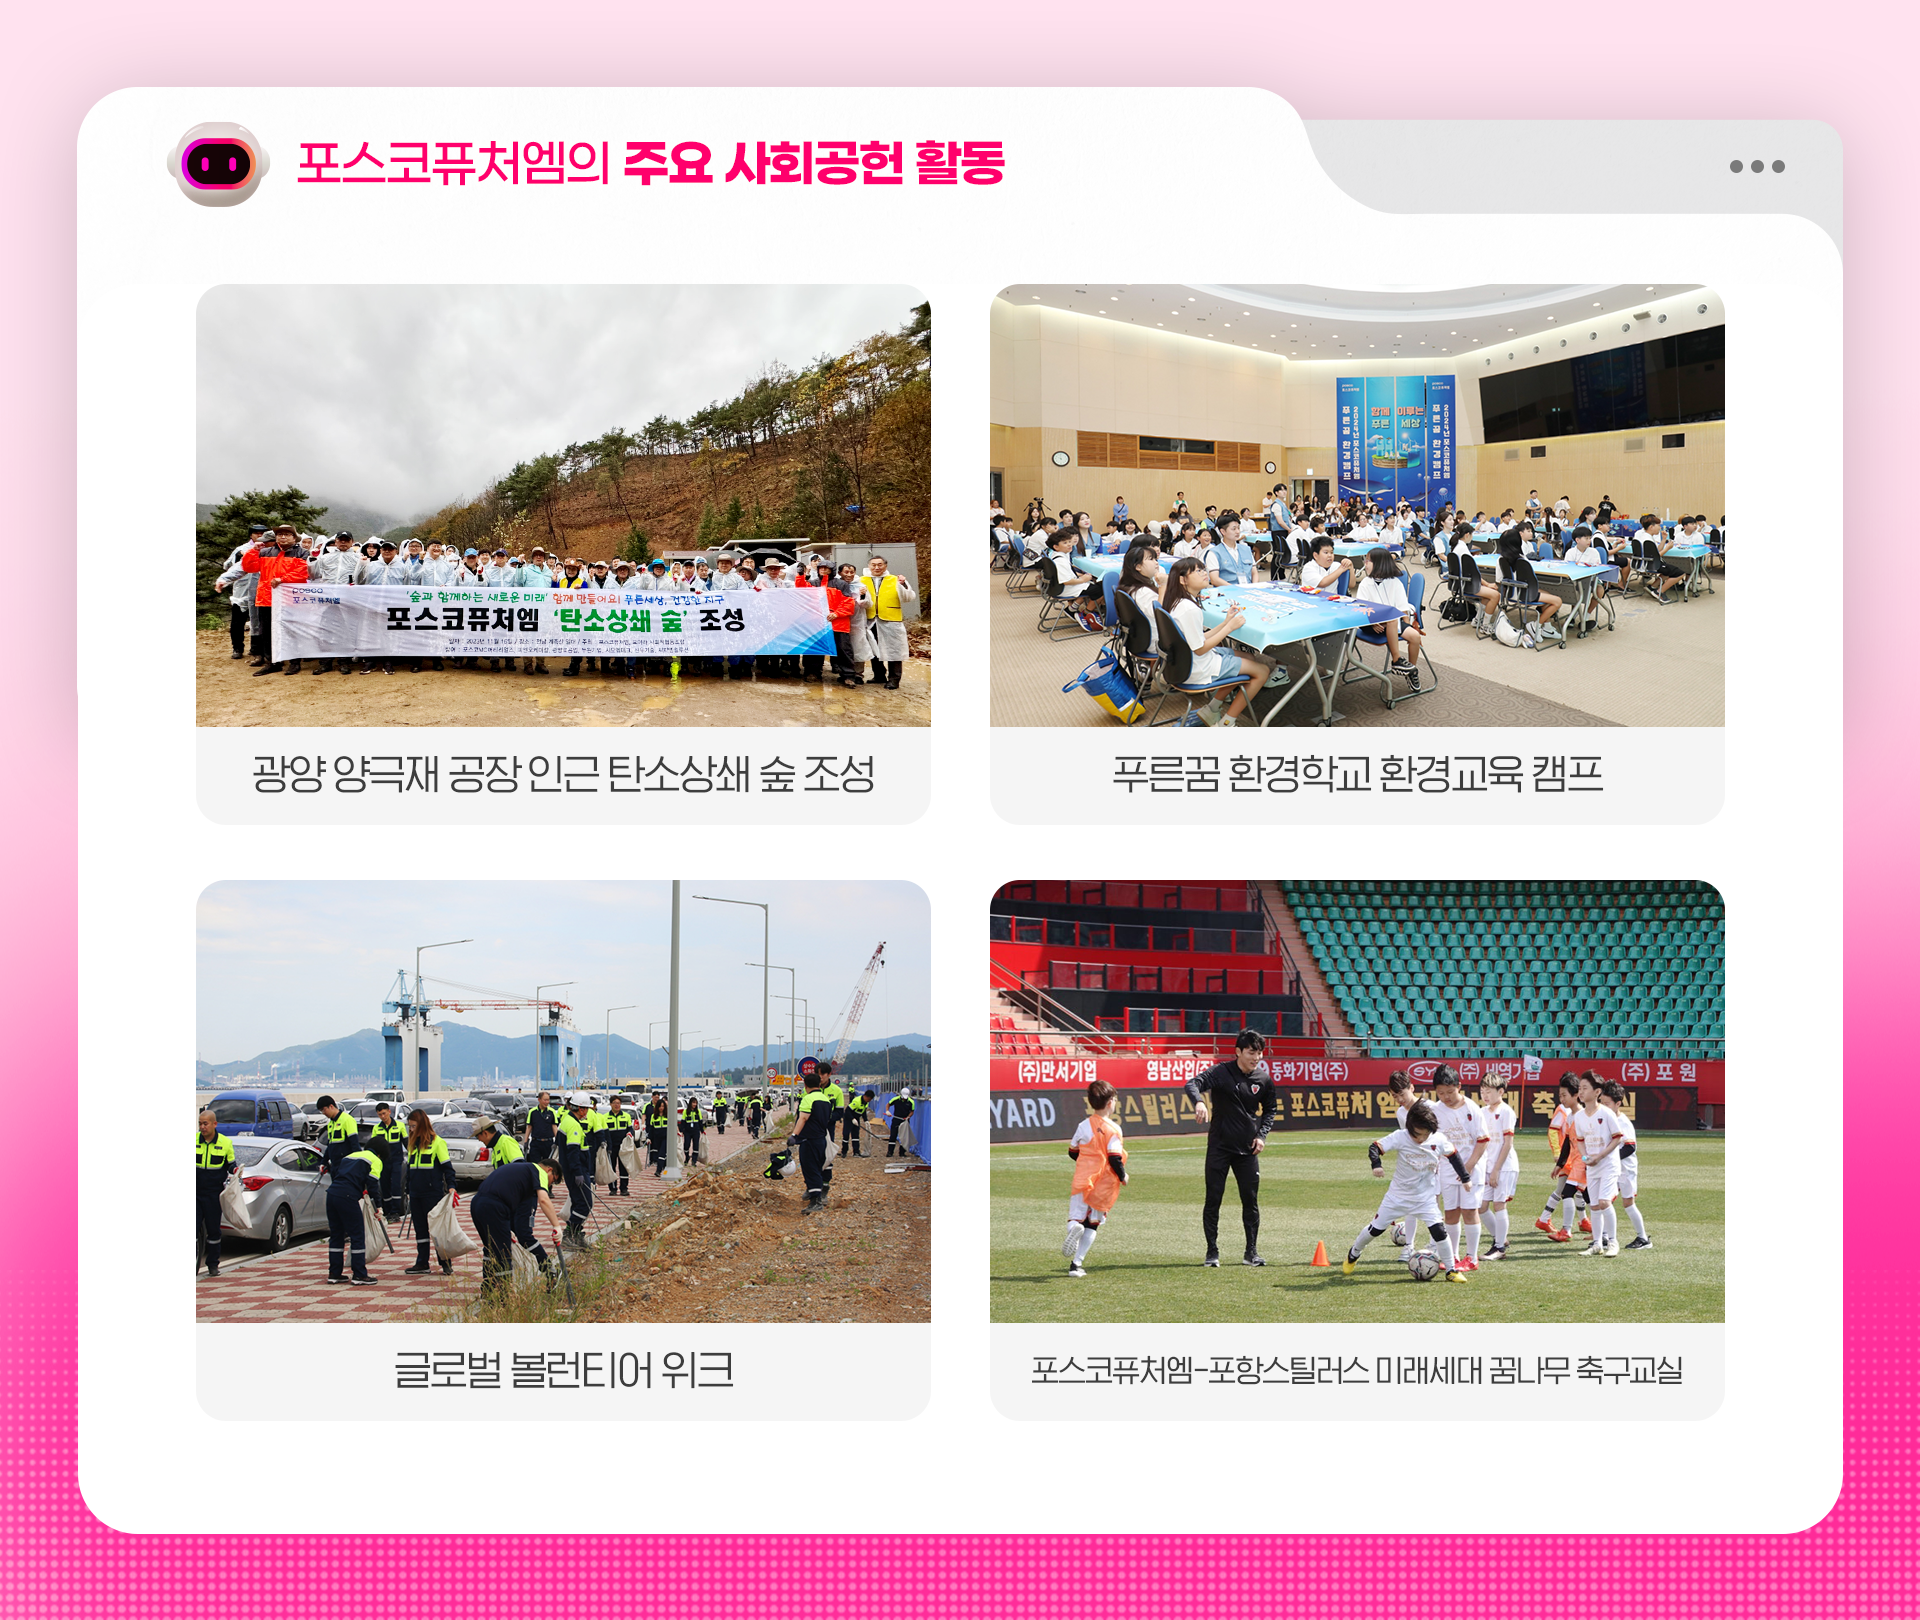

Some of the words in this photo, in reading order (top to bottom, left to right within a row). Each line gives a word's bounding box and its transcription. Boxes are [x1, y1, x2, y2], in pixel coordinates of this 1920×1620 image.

[1371, 406, 1391, 417] 함께
[1397, 406, 1425, 416] 이루는
[1371, 419, 1390, 429] 푸른
[1401, 418, 1421, 429] 세상
[1342, 440, 1351, 480] 환경캠프
[1432, 439, 1441, 479] 환경캠프
[438, 591, 484, 603] 함께하는
[487, 592, 520, 603] 새로운
[552, 593, 573, 605] 함께
[704, 595, 725, 605] 지구
[387, 607, 539, 632] 포스코퓨처엠
[699, 608, 745, 632] 조성
[1018, 1060, 1097, 1083] (주)만서기업
[1271, 1061, 1349, 1082] 동화기업(주)
[1459, 1062, 1480, 1080] (주)
[1621, 1062, 1650, 1082] (주)
[990, 1097, 1056, 1129] YARD
